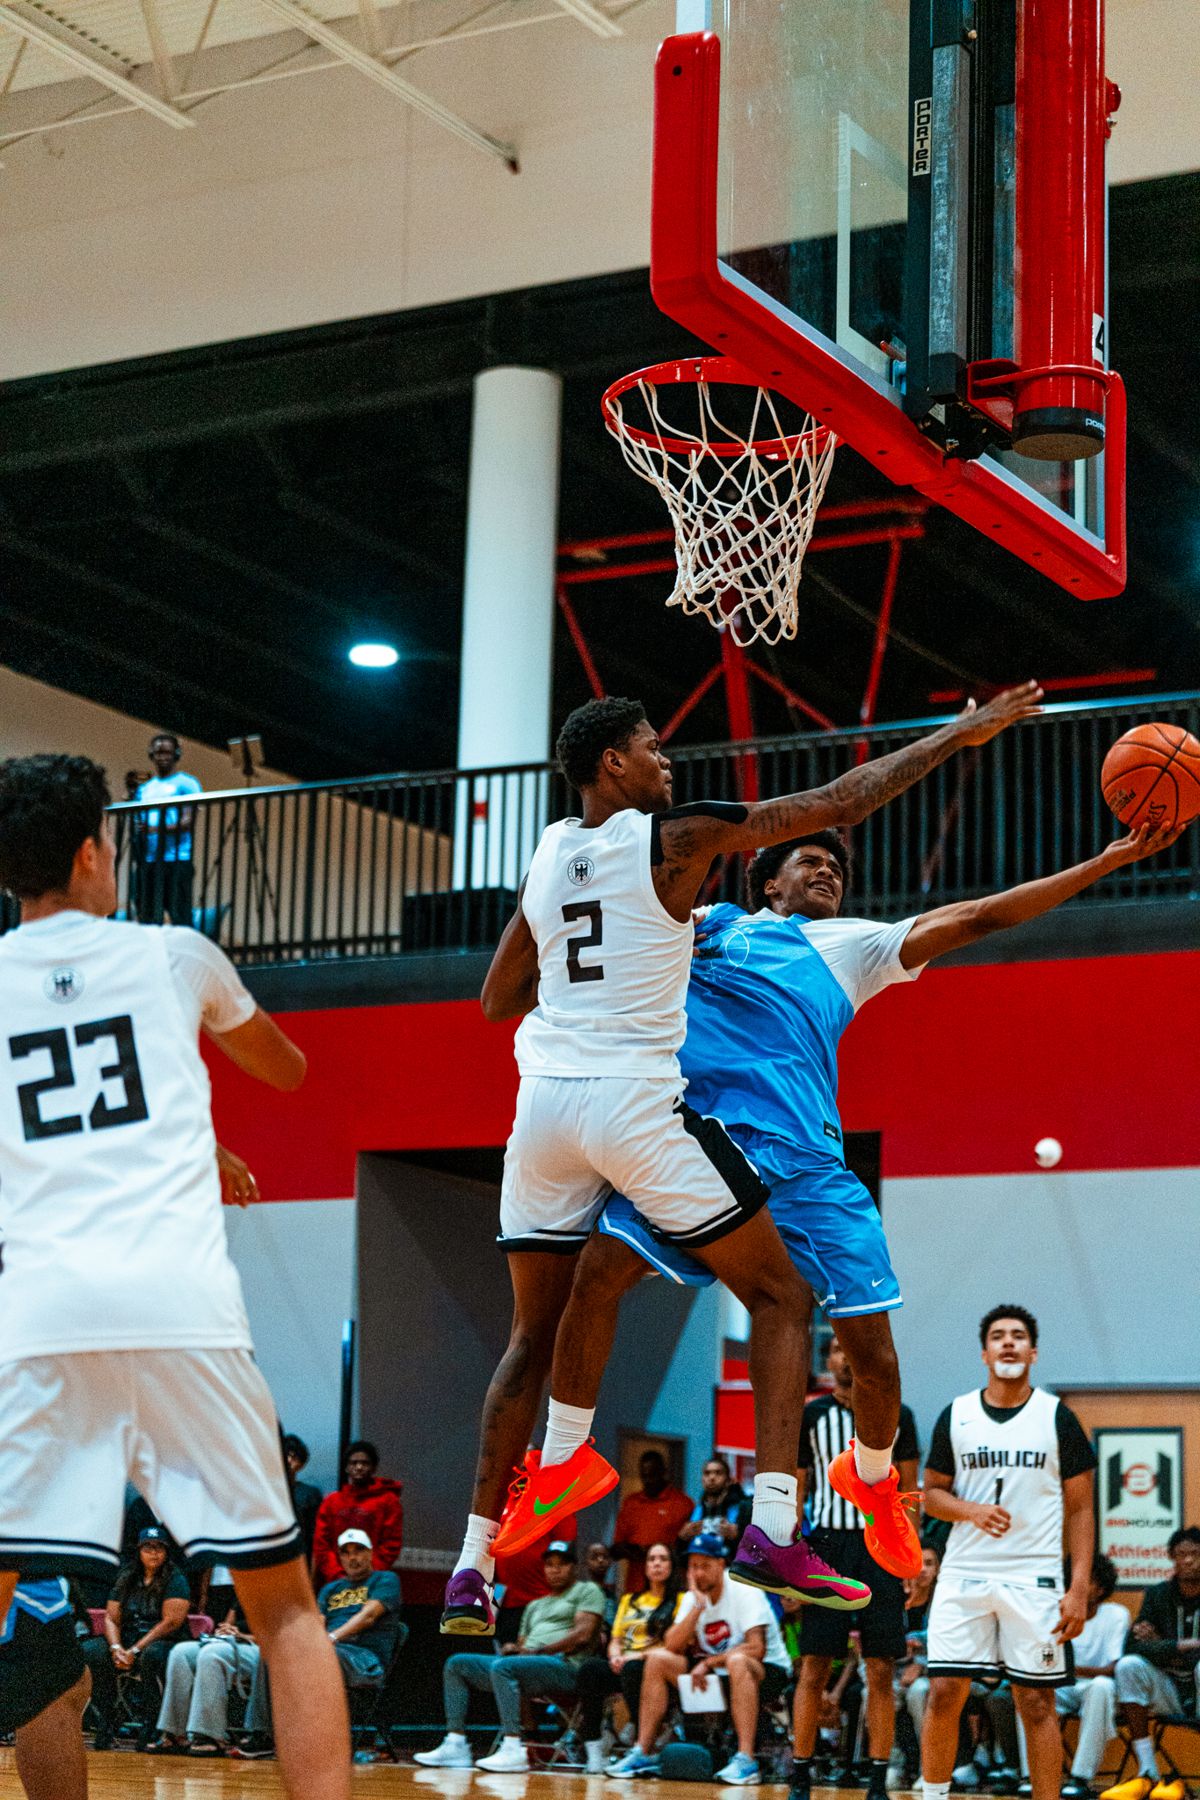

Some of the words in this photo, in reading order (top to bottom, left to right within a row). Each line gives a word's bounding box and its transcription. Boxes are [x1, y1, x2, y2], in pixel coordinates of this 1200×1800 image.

[562, 900, 604, 983] 2
[9, 1014, 149, 1142] 23
[961, 1446, 1046, 1470] FRÖHLICH
[994, 1478, 1004, 1505] 1
